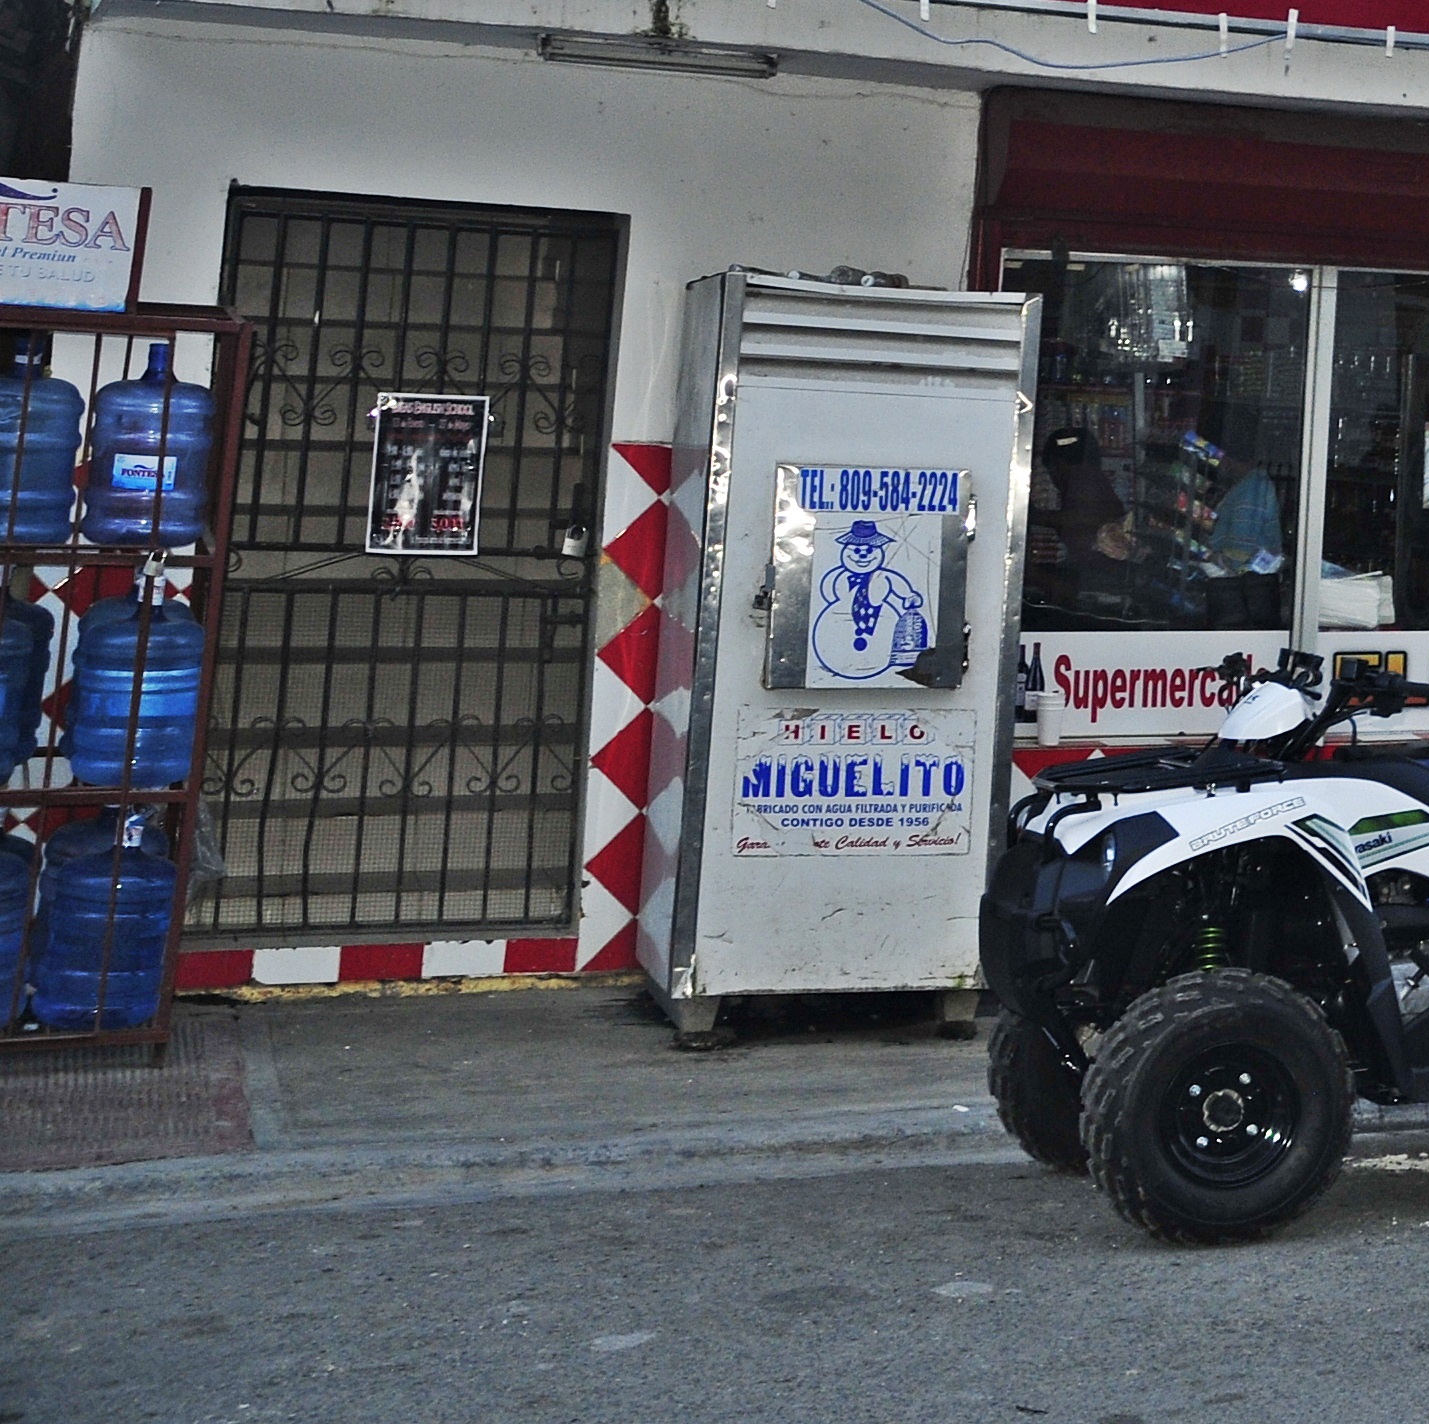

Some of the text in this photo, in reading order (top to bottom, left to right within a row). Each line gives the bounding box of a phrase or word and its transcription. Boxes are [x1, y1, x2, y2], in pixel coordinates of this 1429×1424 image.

[800, 469, 959, 512] TEL.: 809-584-2224
[742, 753, 966, 799] MIGUELITO
[780, 817, 930, 827] CONTIGO DESDE 1956
[802, 804, 823, 814] CON
[825, 804, 852, 814] AGUA
[855, 804, 898, 814] FILTRADA
[901, 804, 907, 814] Y
[1189, 796, 1306, 852] BRUTE FORCE
[835, 835, 888, 850] Calidad
